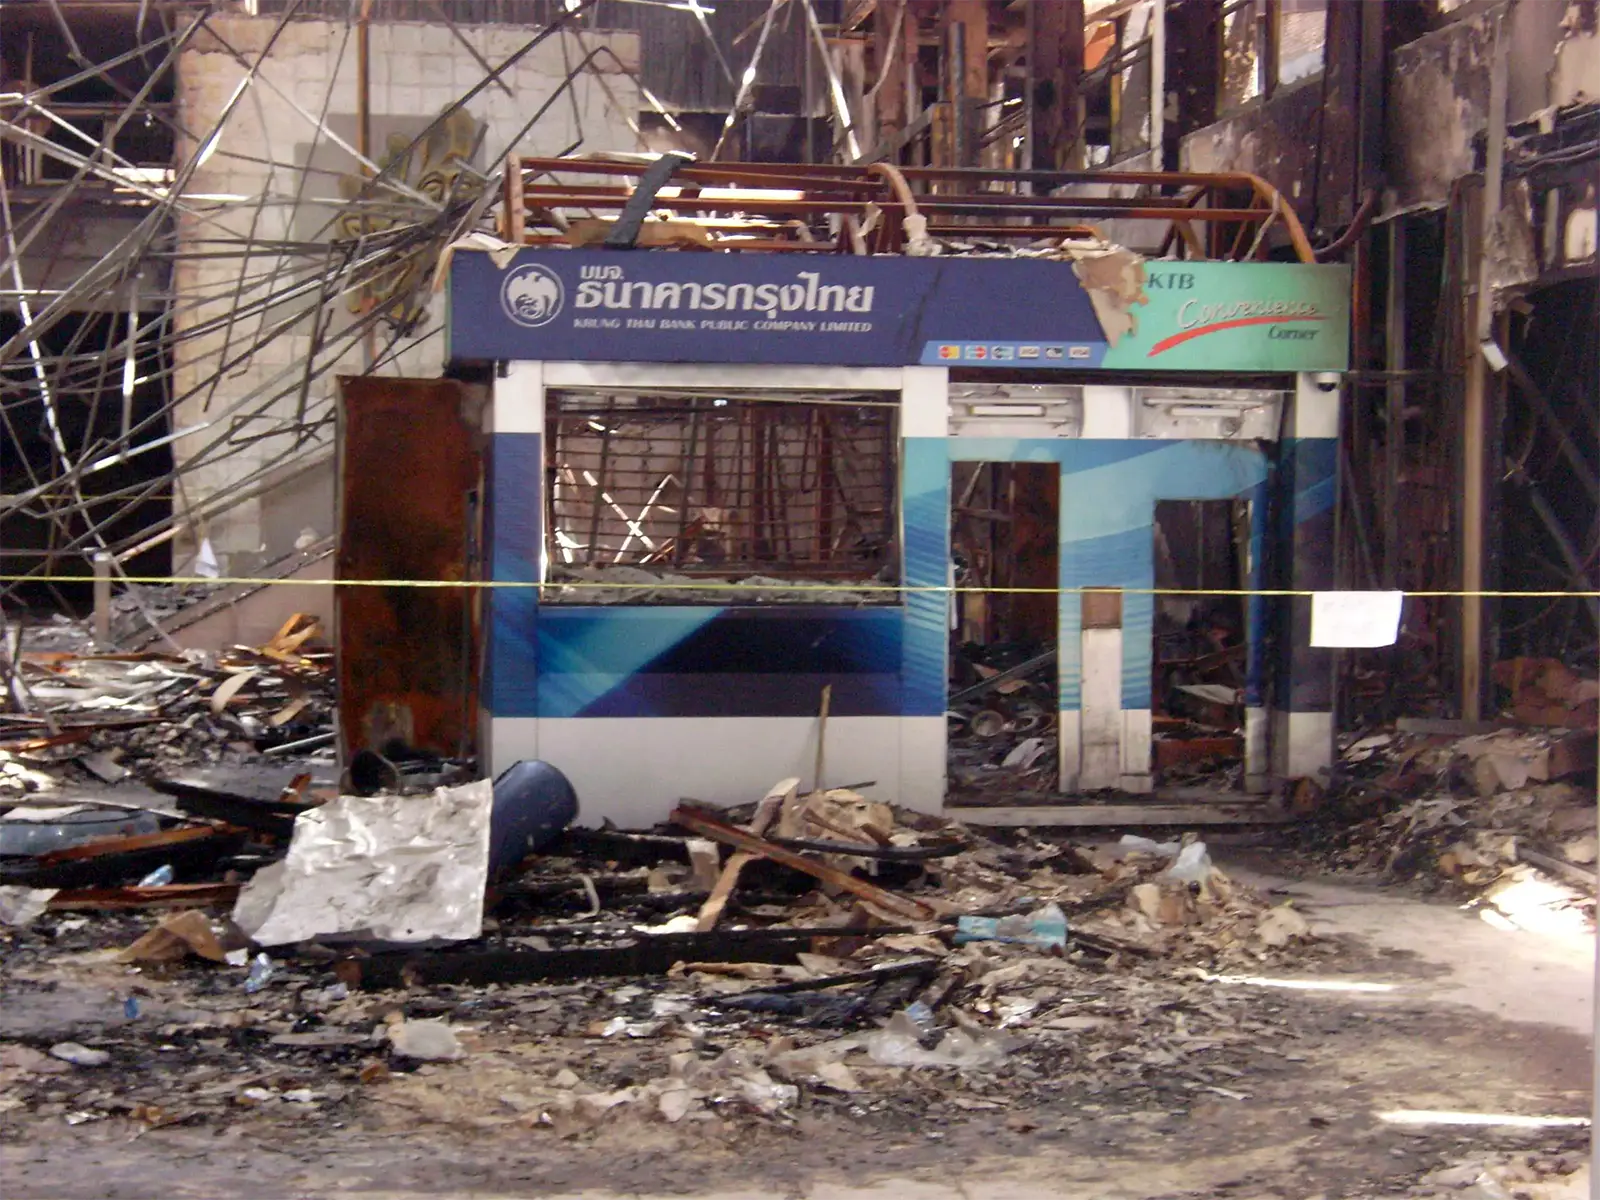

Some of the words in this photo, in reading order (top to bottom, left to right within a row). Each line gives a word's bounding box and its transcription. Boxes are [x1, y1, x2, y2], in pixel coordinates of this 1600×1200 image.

[1148, 273, 1195, 290] KTB
[574, 272, 875, 319] ธนาคารกรุงไทย
[626, 318, 656, 329] THAI
[659, 318, 696, 329] BANK
[700, 319, 749, 331] PUBLIC
[753, 320, 817, 332] COMPANY
[819, 320, 873, 333] LIMITED
[1267, 325, 1320, 341] Corner
